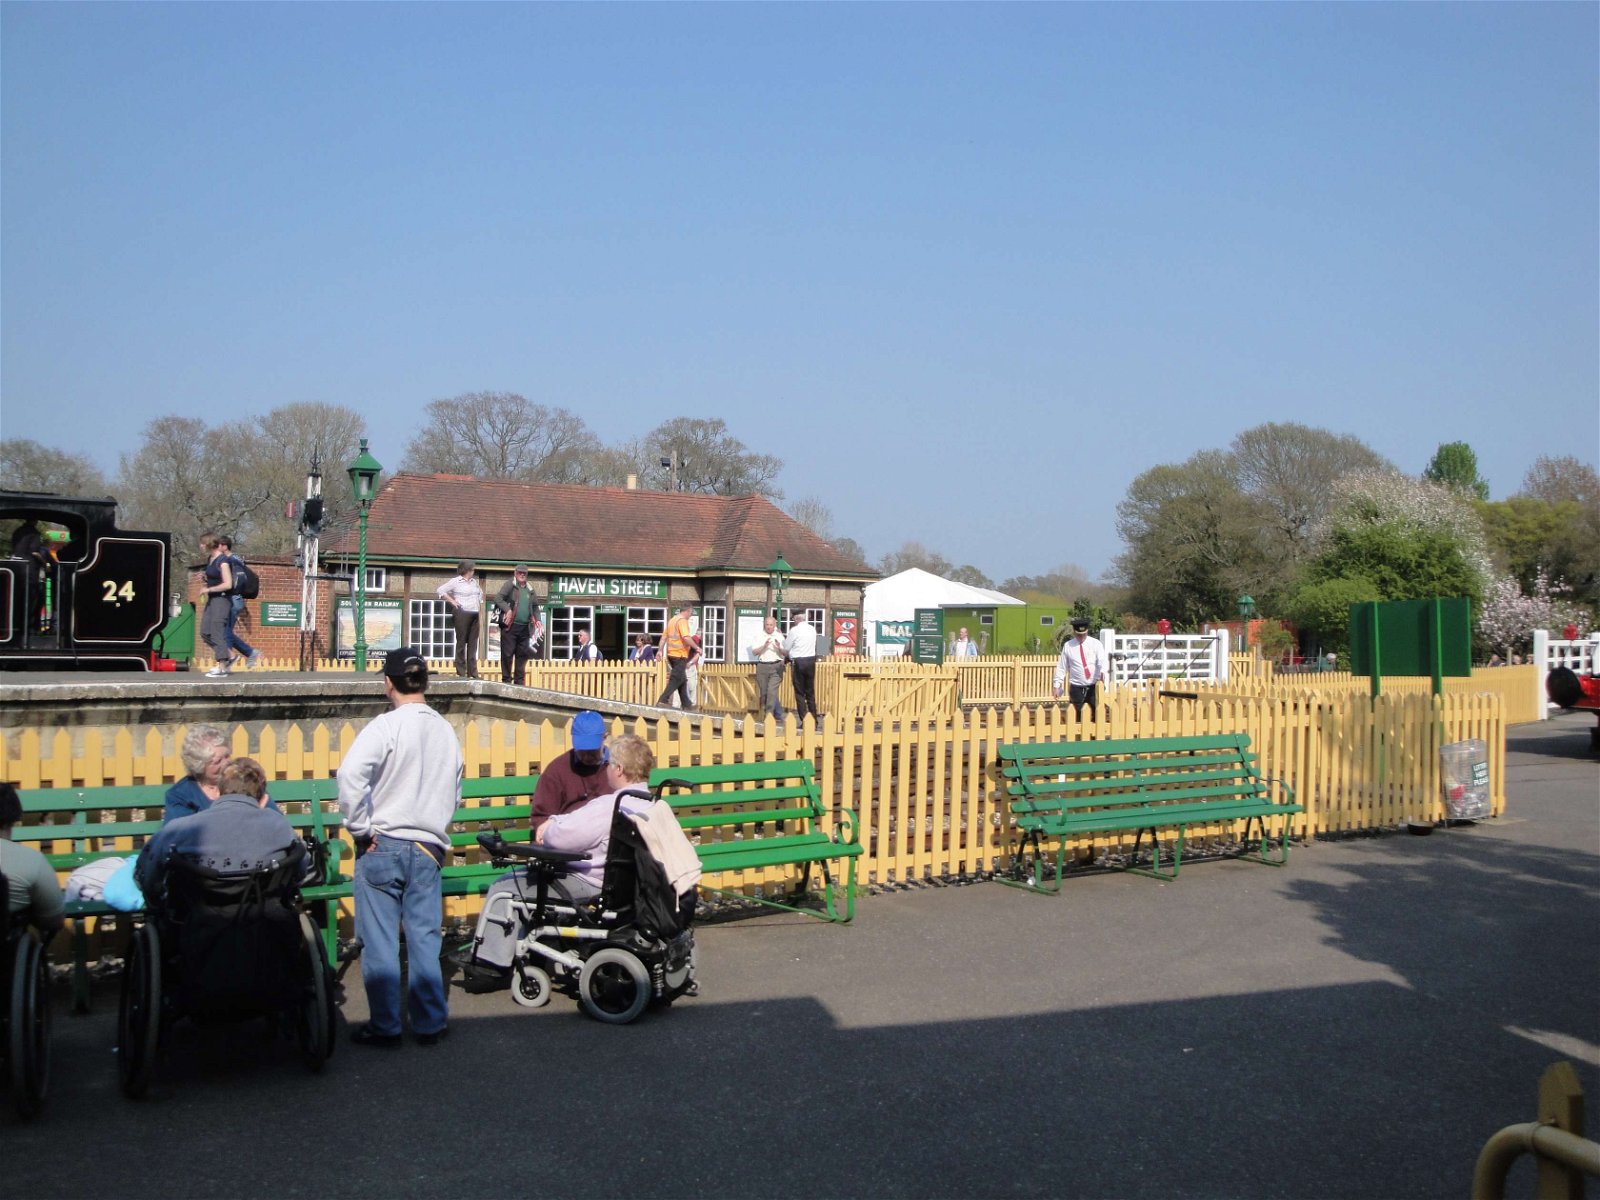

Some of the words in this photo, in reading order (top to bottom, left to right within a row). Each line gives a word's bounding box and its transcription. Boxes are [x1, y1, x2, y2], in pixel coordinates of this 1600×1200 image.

[102, 580, 136, 602] 24
[558, 577, 606, 594] HAVEN
[610, 579, 661, 595] STREET
[881, 624, 913, 638] REAL
[1473, 776, 1489, 786] PLEAS
